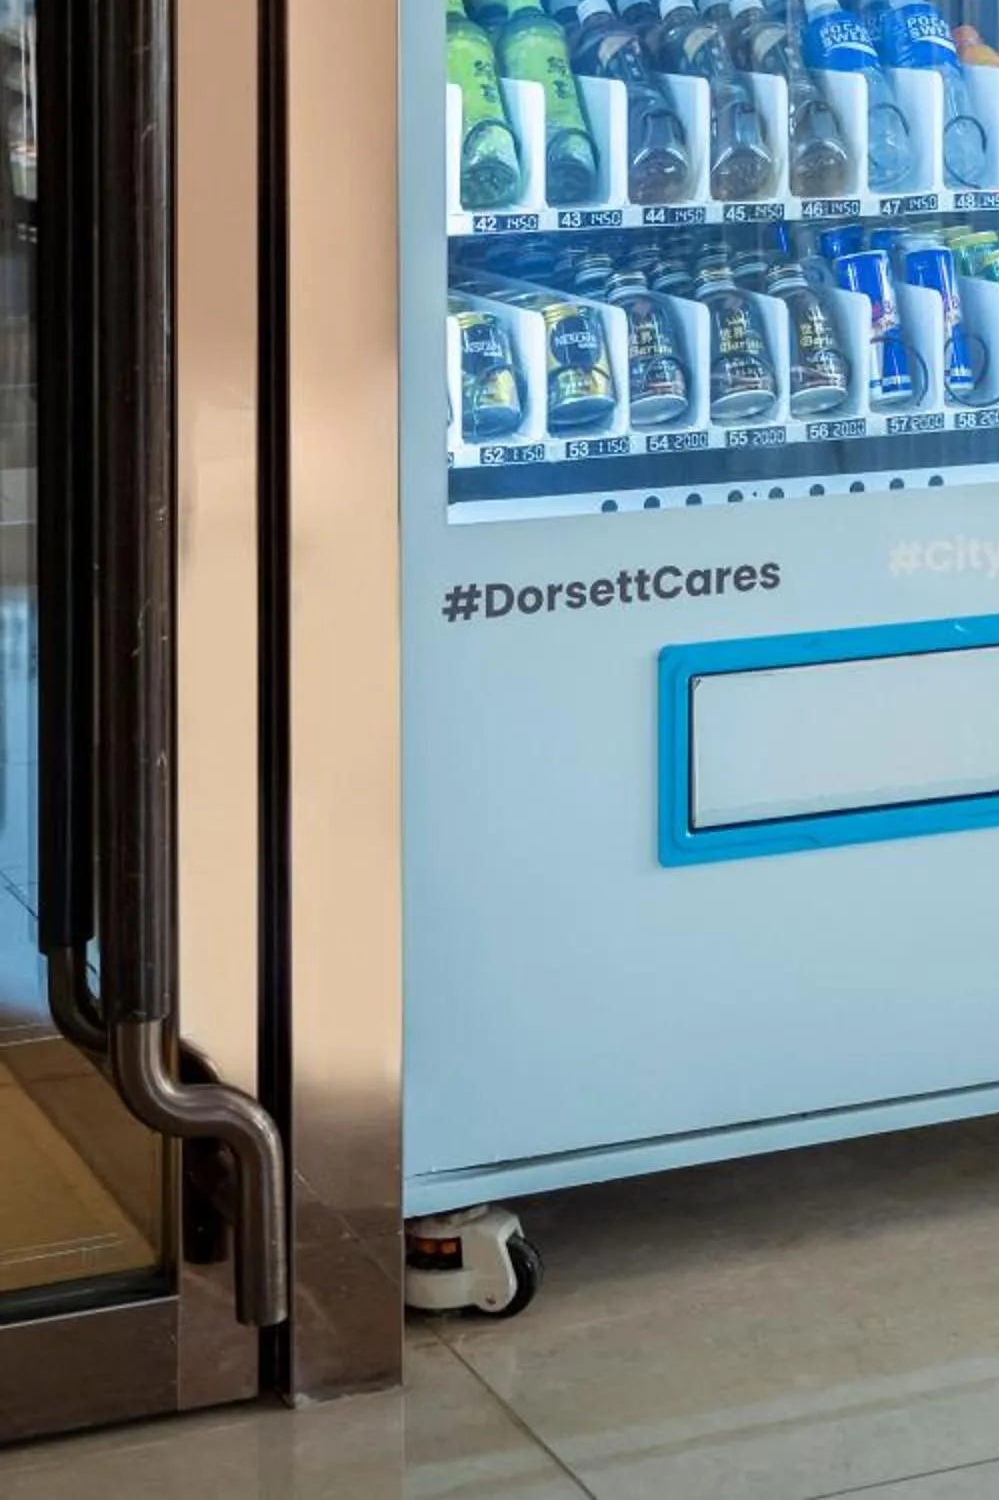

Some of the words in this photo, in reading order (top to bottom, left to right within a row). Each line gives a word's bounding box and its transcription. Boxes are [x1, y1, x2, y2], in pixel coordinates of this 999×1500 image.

[726, 206, 746, 221] 45
[804, 203, 823, 217] 46
[882, 202, 900, 215] 47
[561, 213, 581, 228] 43
[645, 209, 665, 223] 44
[476, 217, 497, 232] 42
[810, 424, 828, 438] 56
[890, 418, 907, 432] 57
[650, 437, 669, 451] 54
[729, 432, 748, 446] 55
[483, 449, 504, 463] 52
[569, 442, 588, 457] 53
[442, 562, 780, 622] #DorsettCares
